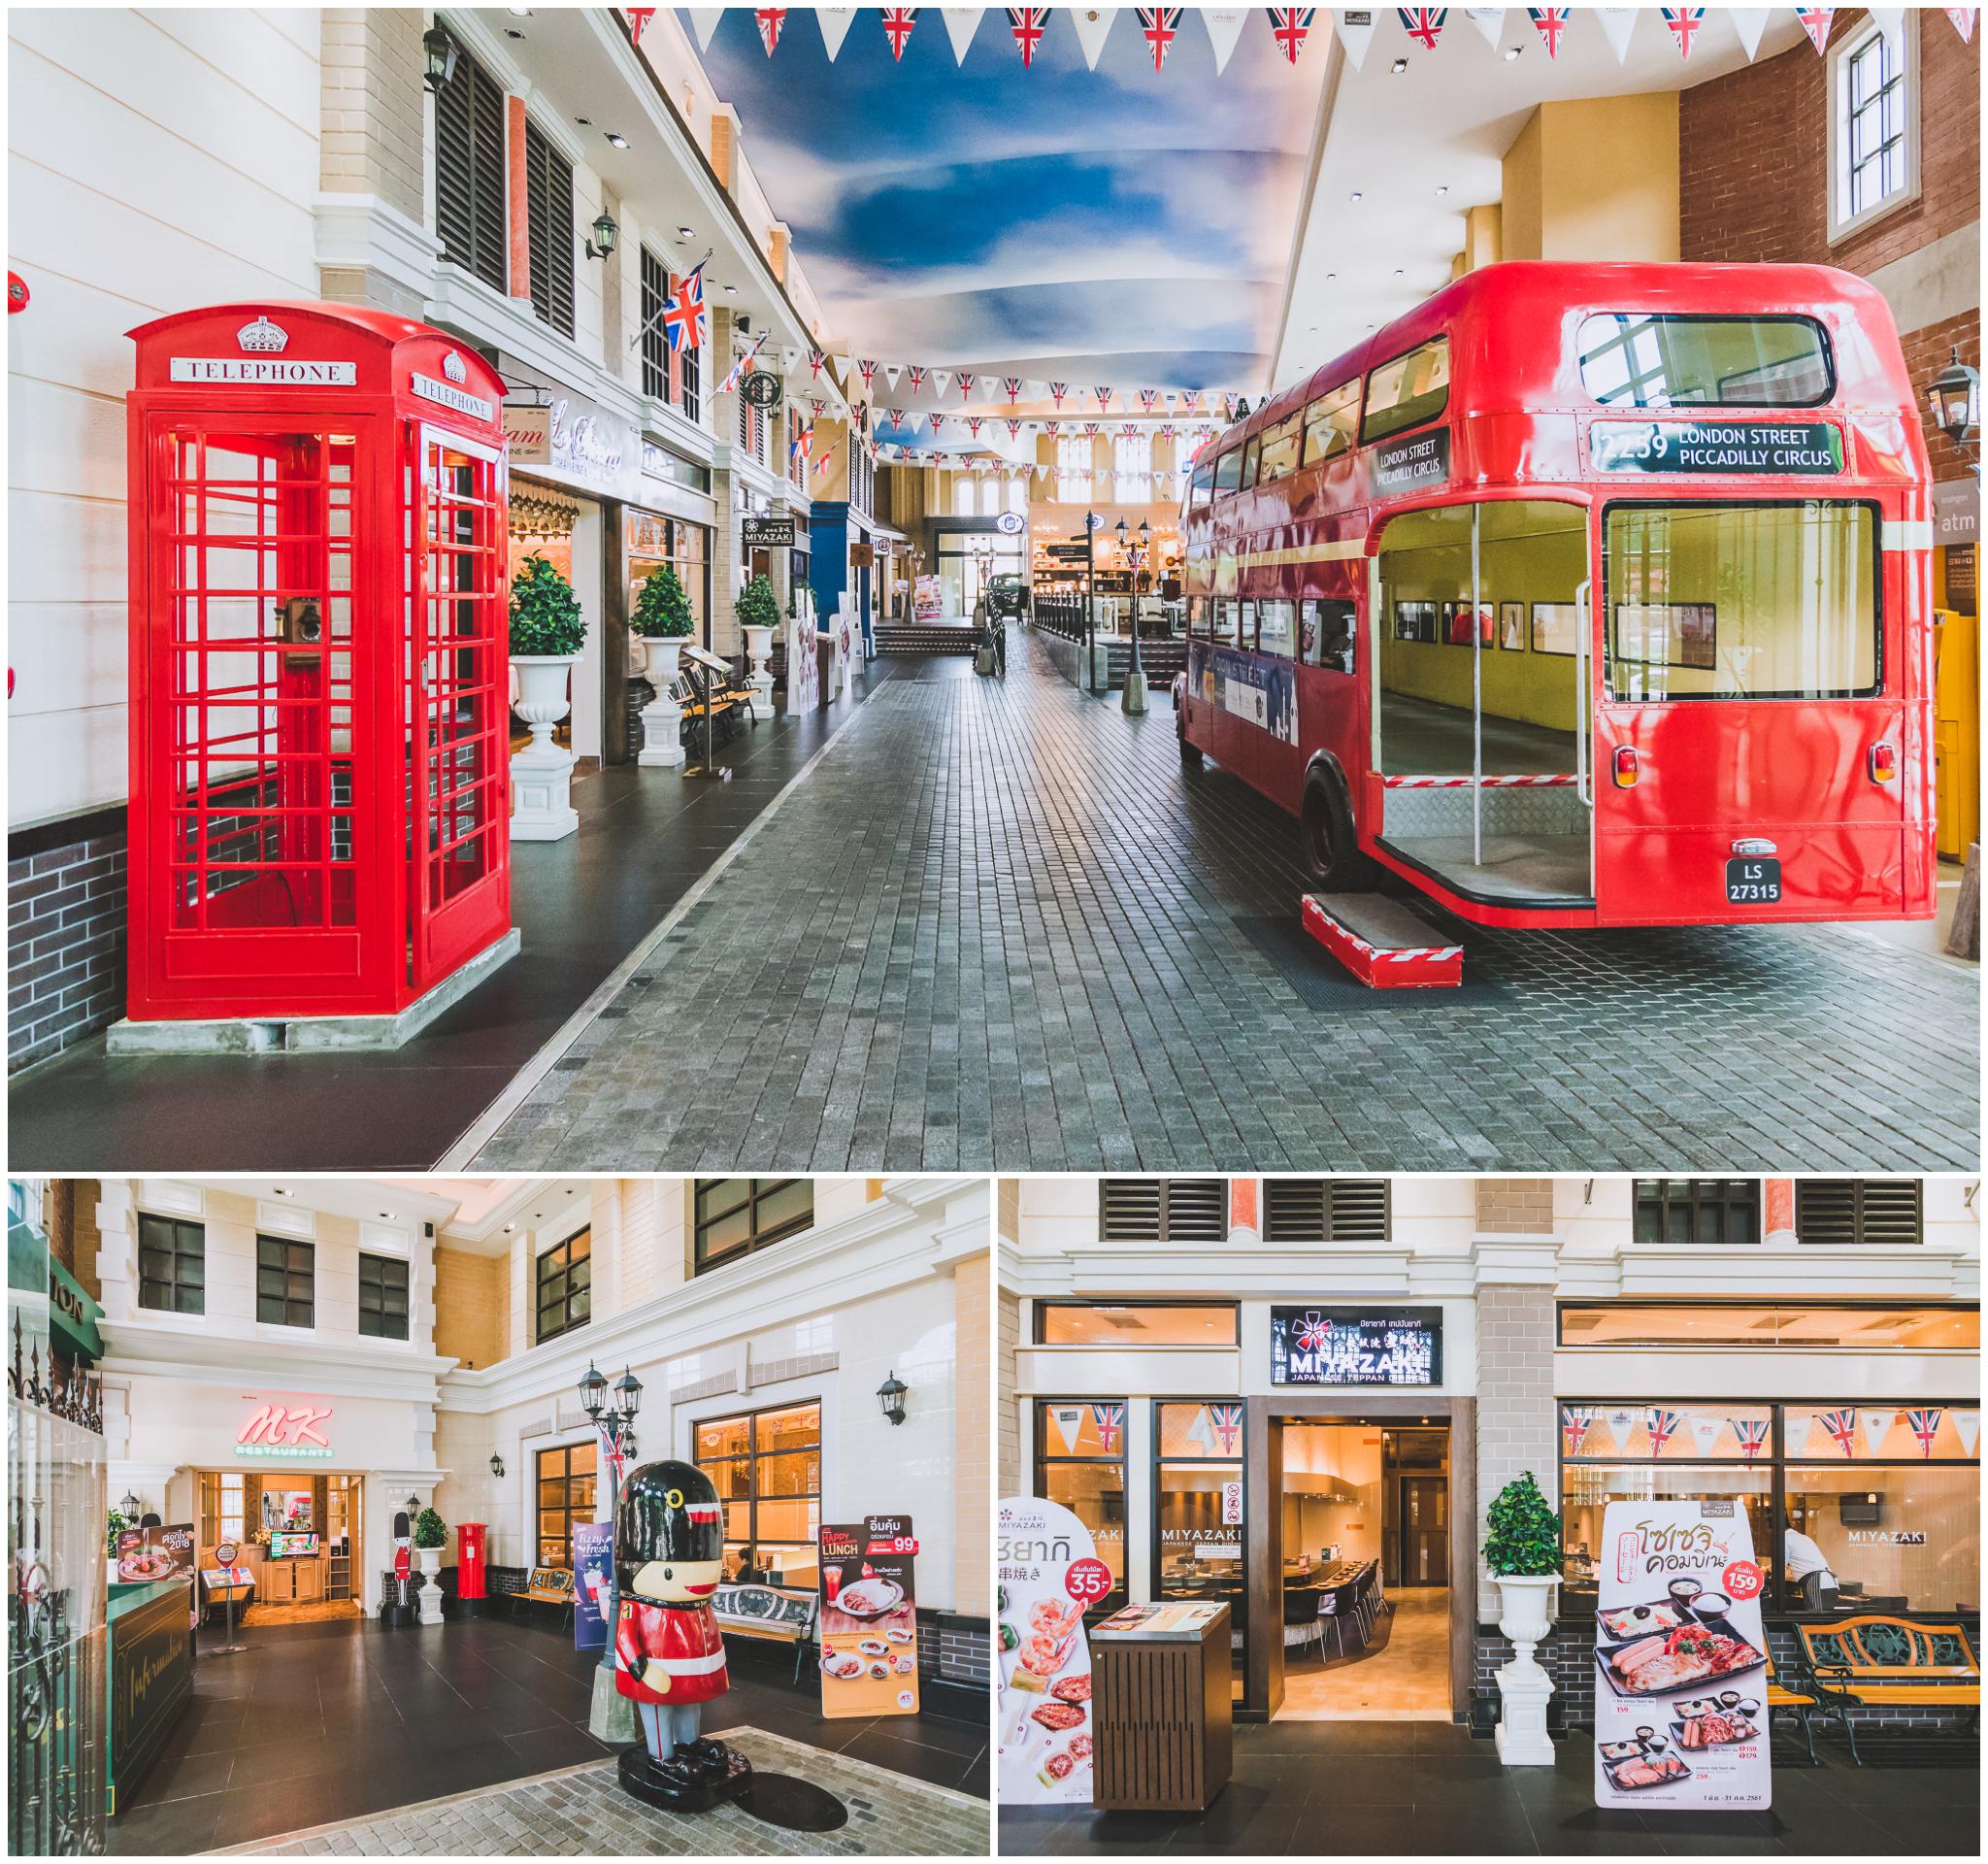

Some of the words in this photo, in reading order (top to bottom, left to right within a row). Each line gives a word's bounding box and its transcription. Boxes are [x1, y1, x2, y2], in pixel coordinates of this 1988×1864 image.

[186, 361, 341, 382] TELEPHONE
[421, 378, 487, 417] TELEPHONE
[1678, 428, 1747, 445] LONDON
[1750, 429, 1810, 445] STREET
[1380, 449, 1408, 469] LONDON
[1408, 439, 1436, 460] STREET
[1601, 433, 1669, 459] 2259
[1679, 449, 1770, 466] PICCADILLY
[1773, 450, 1833, 466] CIRCUS
[1376, 466, 1413, 486] PICCADILLY
[1413, 457, 1441, 478] CIRCUS
[1941, 514, 1974, 531] atm
[1744, 865, 1763, 880] LS
[1730, 884, 1778, 900] 27315
[1290, 1353, 1424, 1374] MIYAZAKI
[236, 1405, 333, 1448] MK
[235, 1447, 334, 1457] RESTAURANTS
[822, 1532, 849, 1545] HAPPY
[1162, 1529, 1242, 1541] MIYAZAKI
[1848, 1531, 1927, 1542] MIYAZAKI
[169, 1539, 190, 1550] 2018
[822, 1544, 858, 1556] LUNCH
[999, 1566, 1041, 1581] 串焼き
[1728, 1572, 1758, 1591] 159
[130, 1633, 182, 1717] Information
